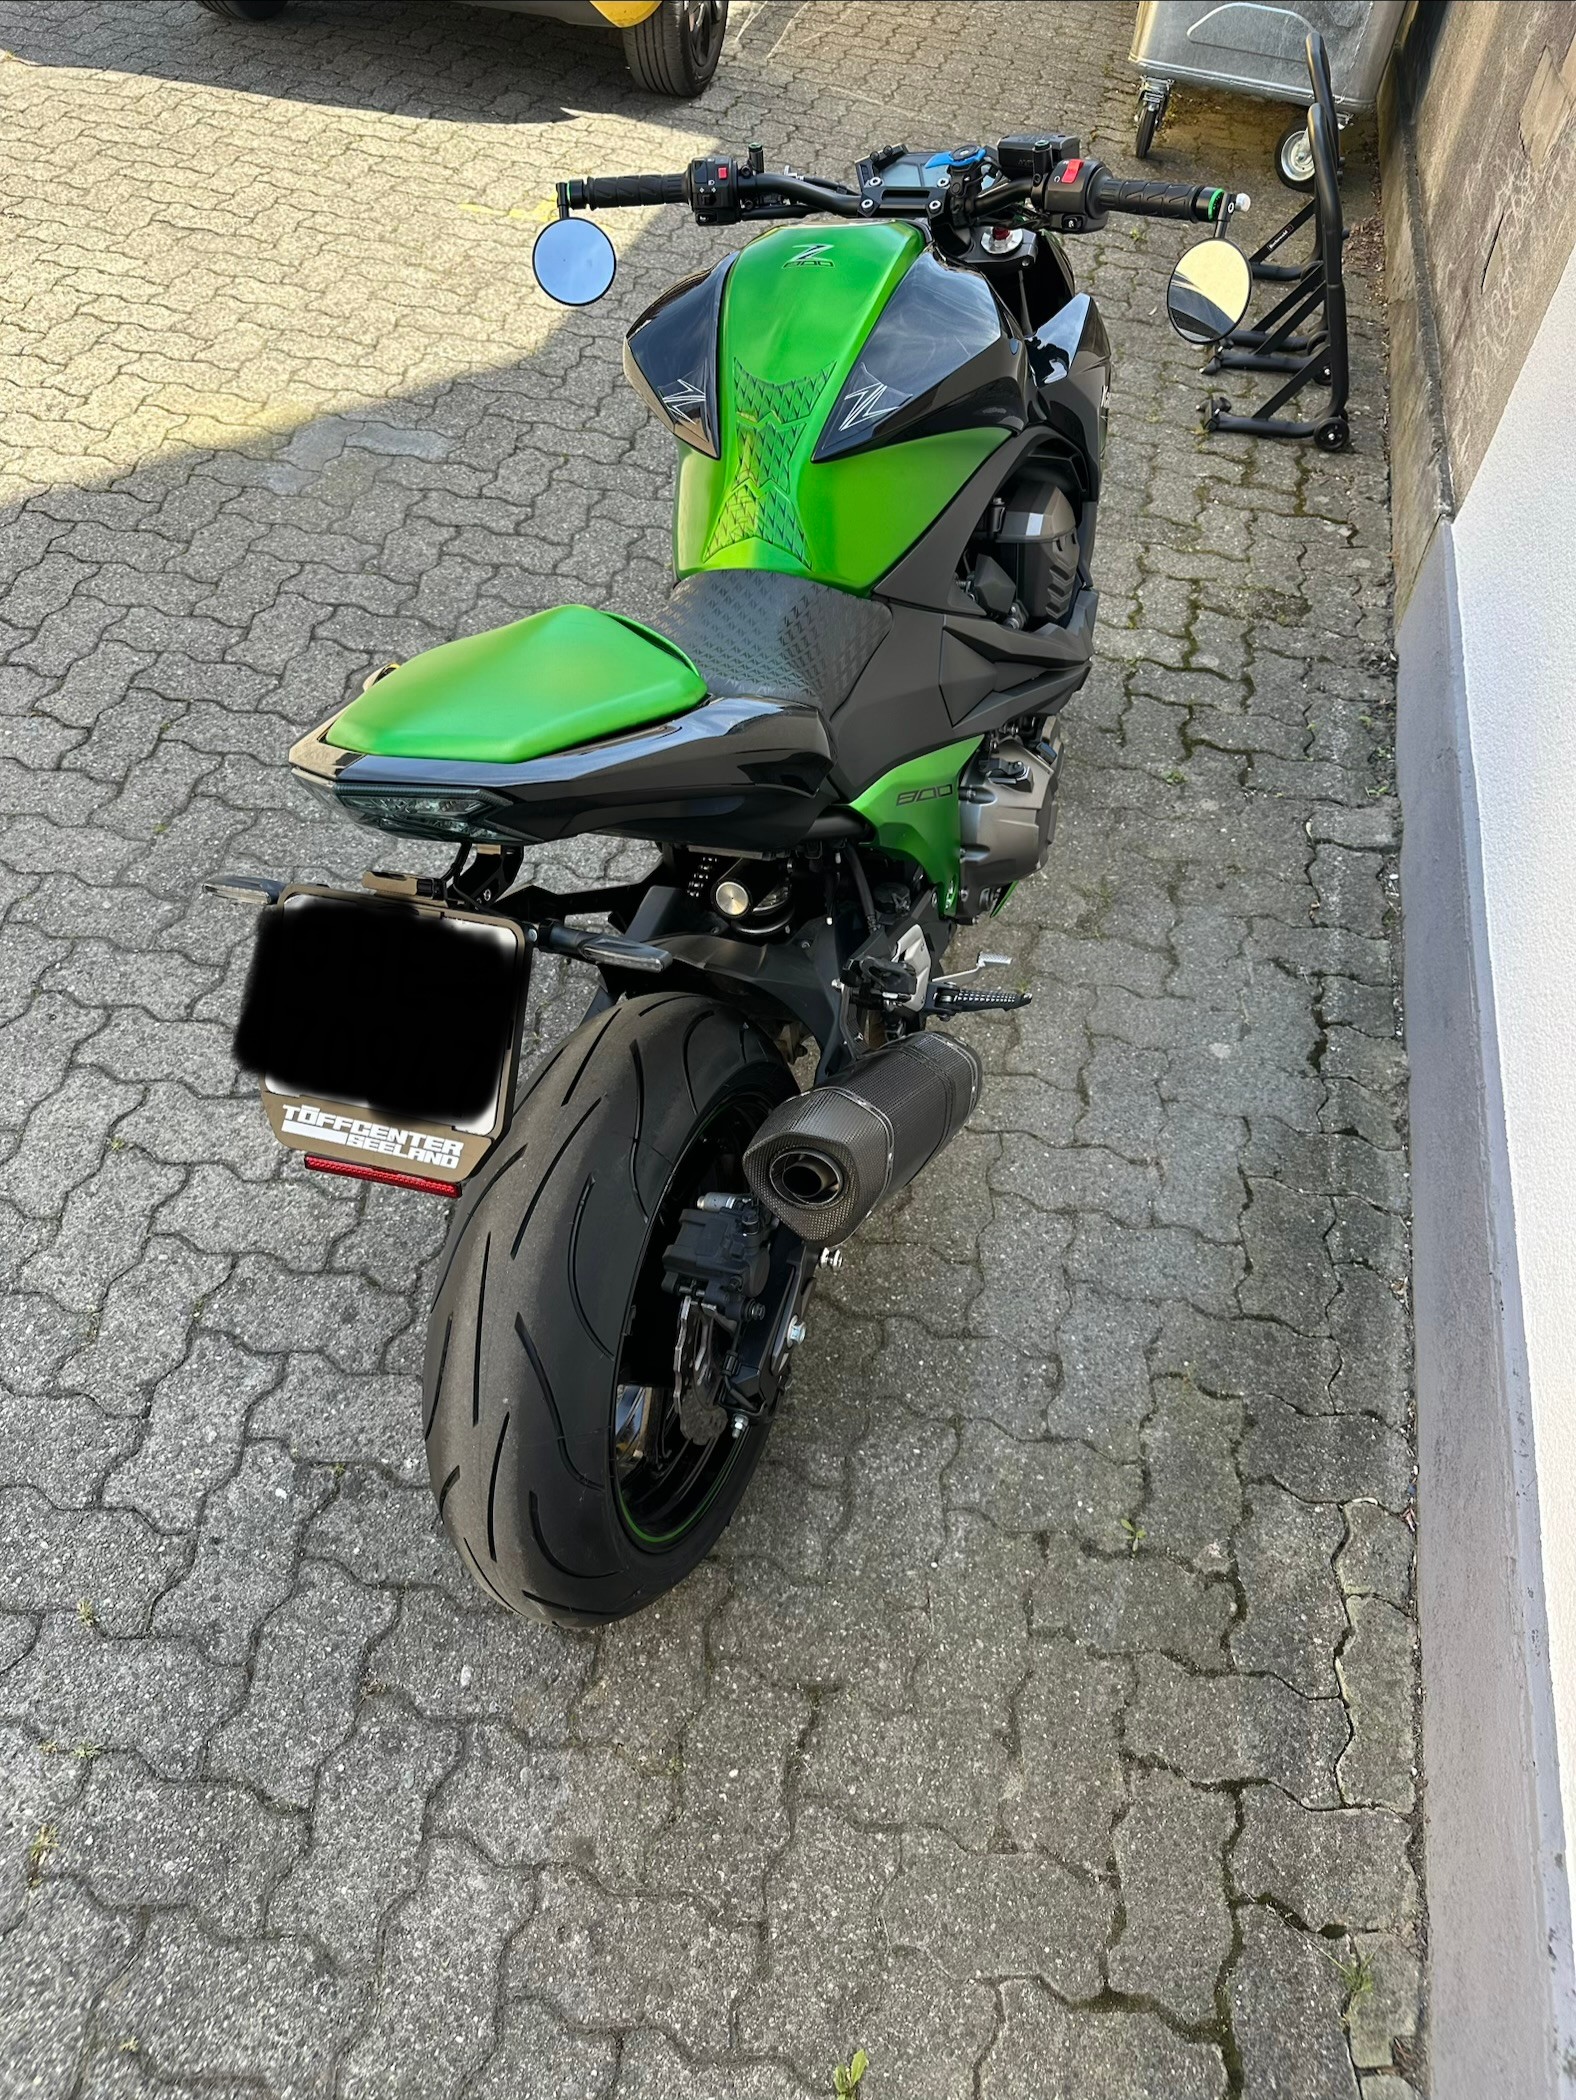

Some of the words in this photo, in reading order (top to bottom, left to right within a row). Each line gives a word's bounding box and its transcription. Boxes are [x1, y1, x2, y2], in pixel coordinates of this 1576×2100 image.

[791, 243, 835, 261] Z
[896, 784, 953, 806] 800
[346, 1134, 460, 1169] SEELAND
